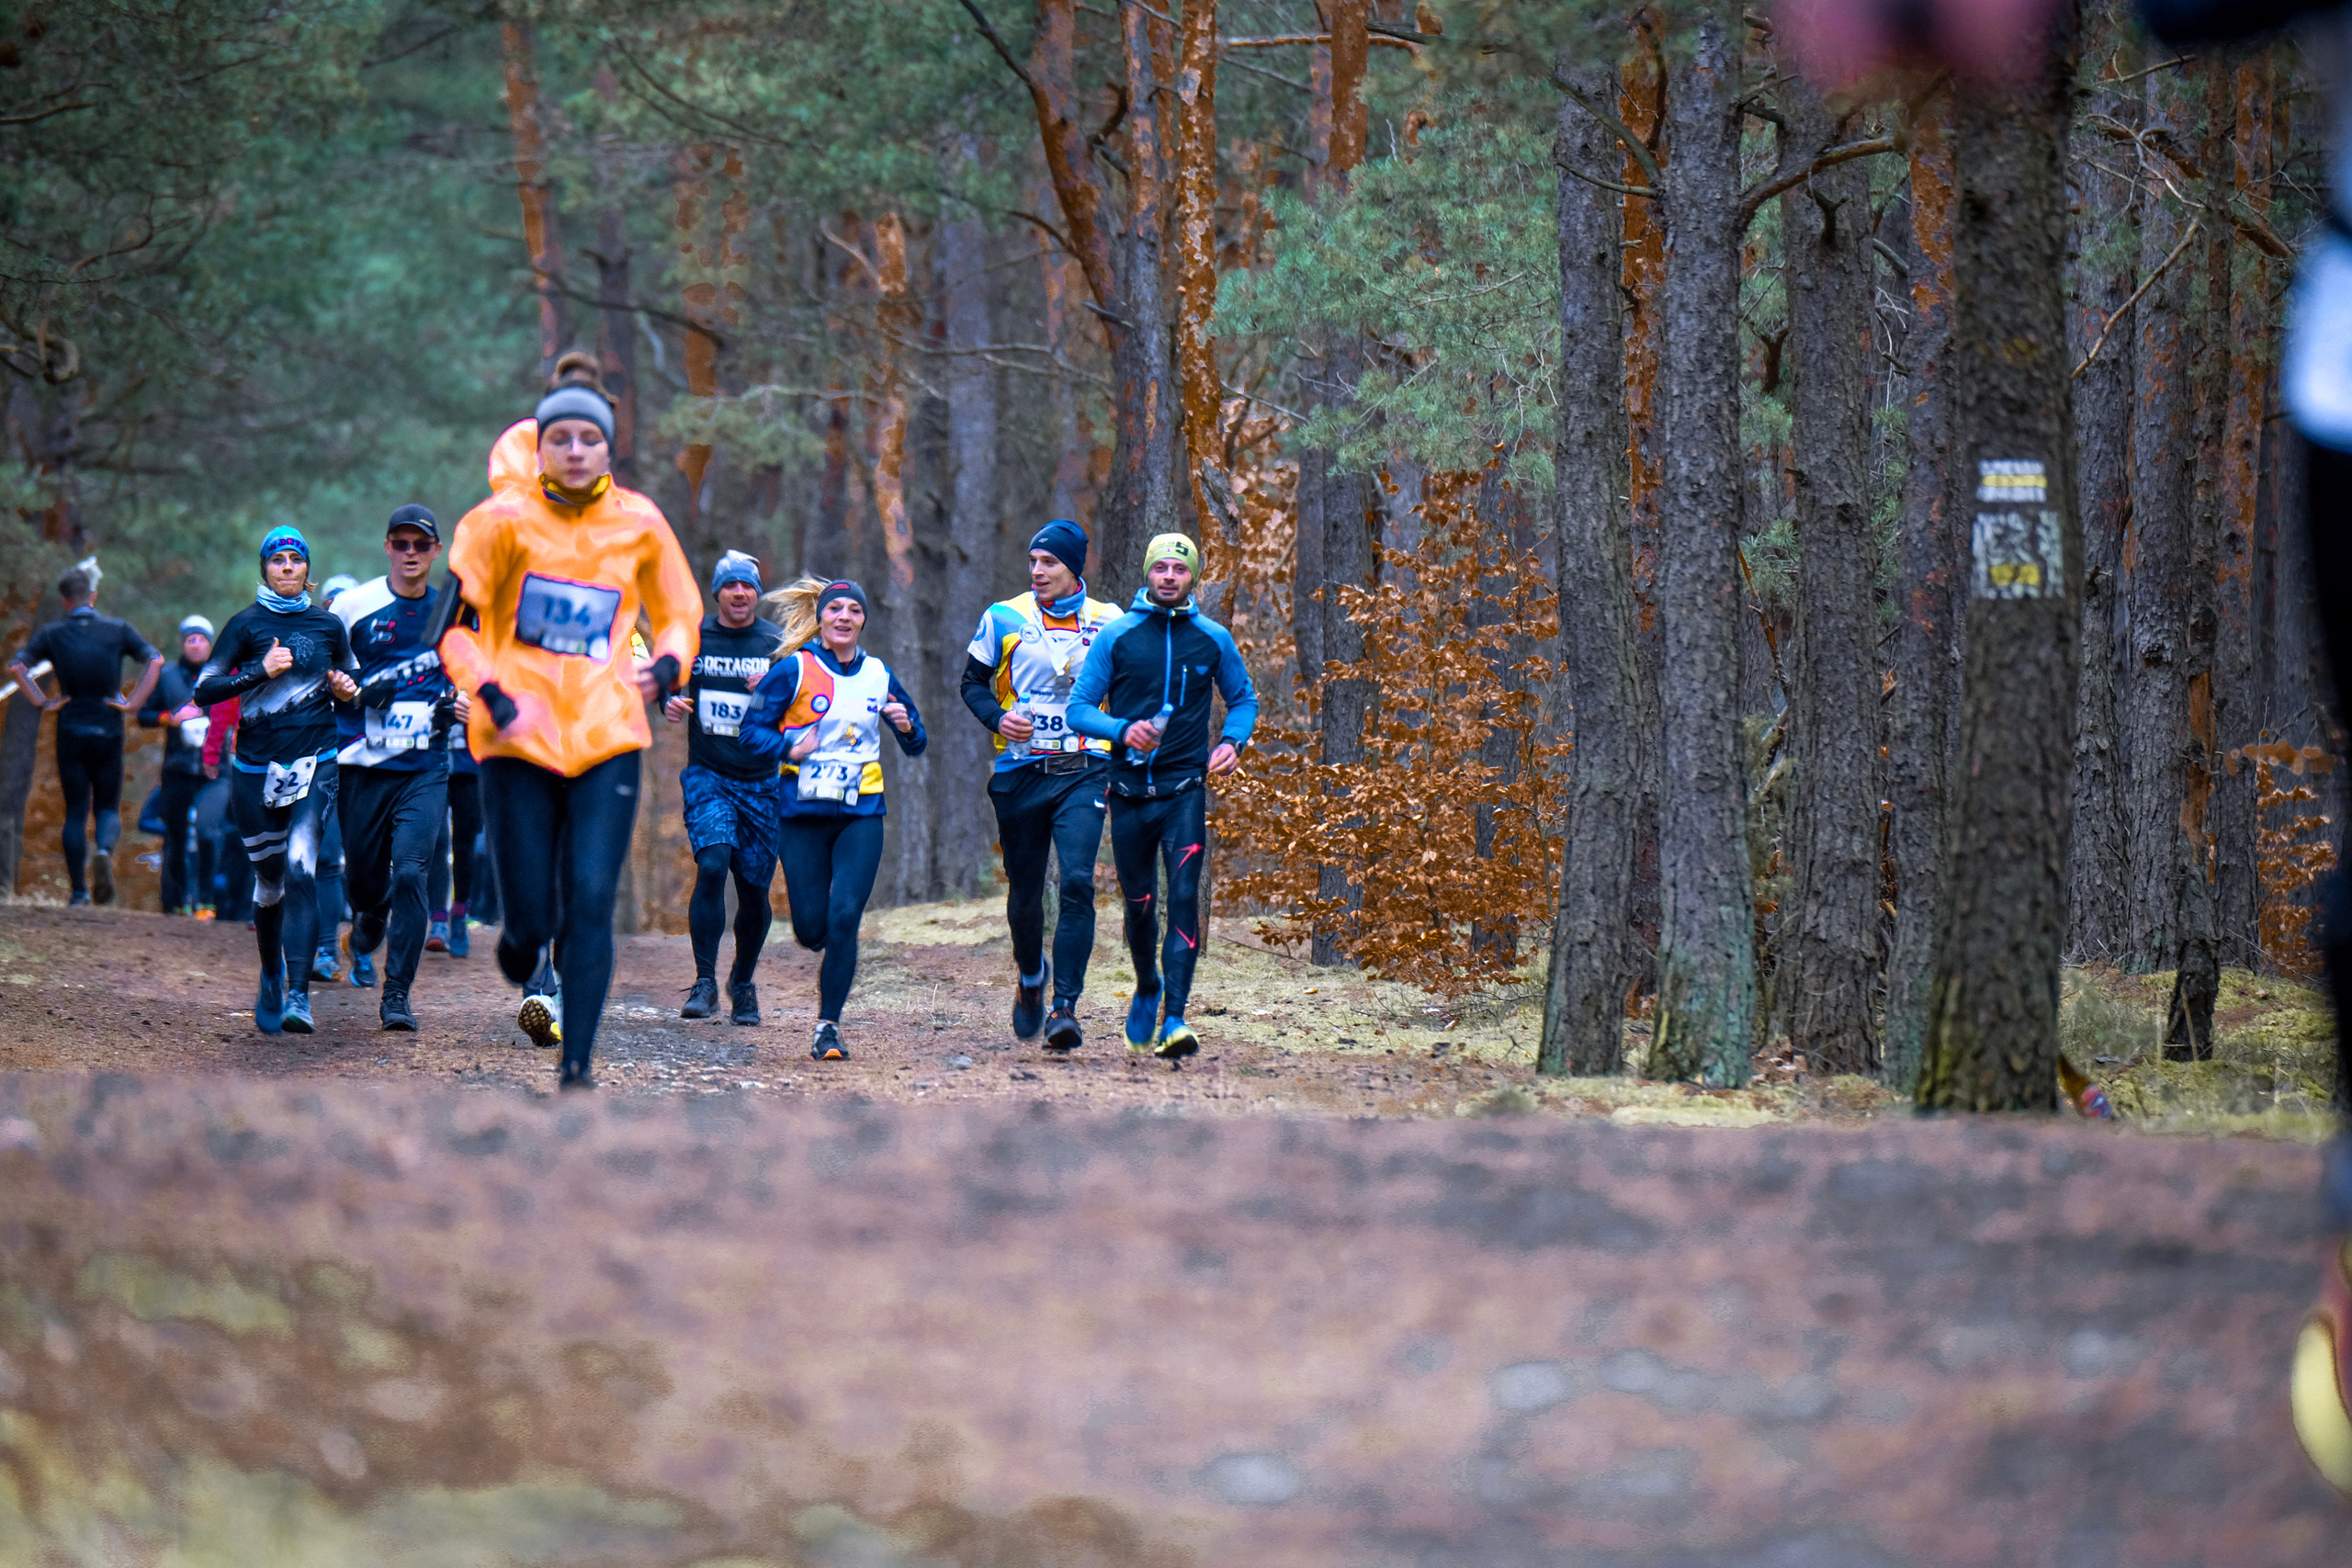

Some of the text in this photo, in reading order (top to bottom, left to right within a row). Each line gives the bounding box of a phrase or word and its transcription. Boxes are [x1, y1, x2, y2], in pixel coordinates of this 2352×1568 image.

[543, 595, 591, 626] 134
[704, 655, 770, 677] OCTAGON
[710, 701, 741, 719] 183
[379, 715, 413, 729] 147
[1032, 715, 1063, 731] 38
[810, 764, 848, 781] 273
